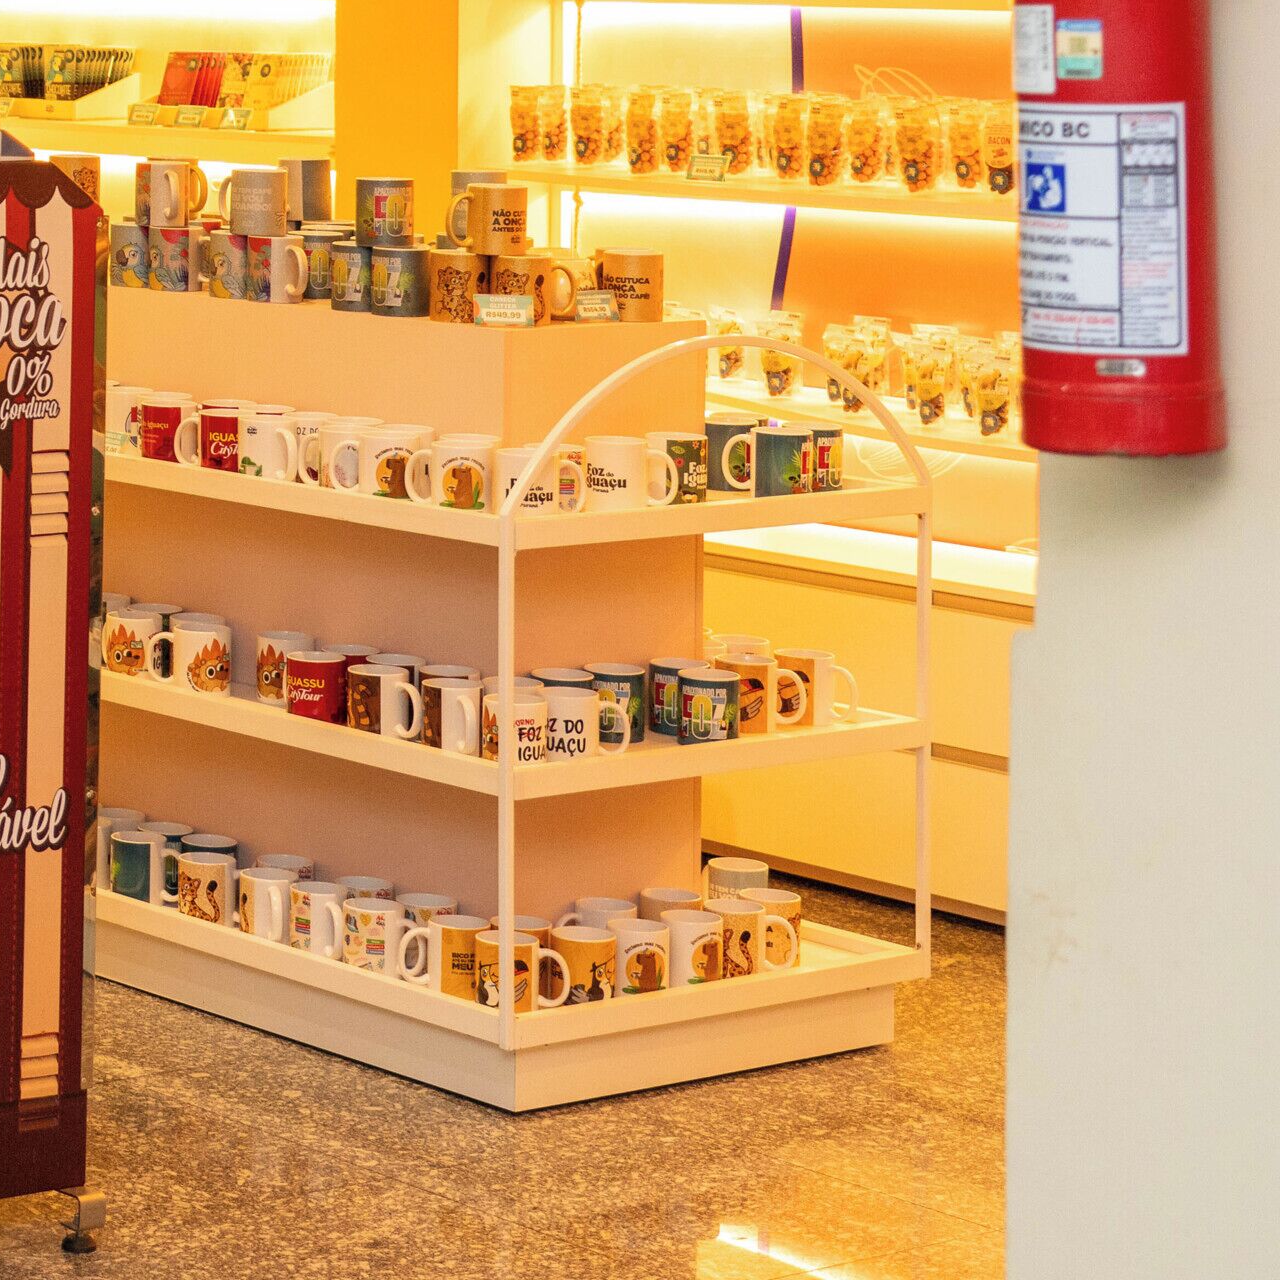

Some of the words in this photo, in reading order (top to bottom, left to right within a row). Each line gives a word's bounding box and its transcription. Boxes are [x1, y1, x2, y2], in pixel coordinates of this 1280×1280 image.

[1062, 121, 1090, 138] BC
[492, 208, 511, 218] NÃO
[492, 218, 501, 226] A
[615, 276, 650, 285] CUTUCA
[6, 353, 52, 397] 0%
[0, 396, 59, 429] Gordura
[714, 688, 727, 698] POR
[564, 719, 584, 735] DO
[451, 963, 474, 971] MEU
